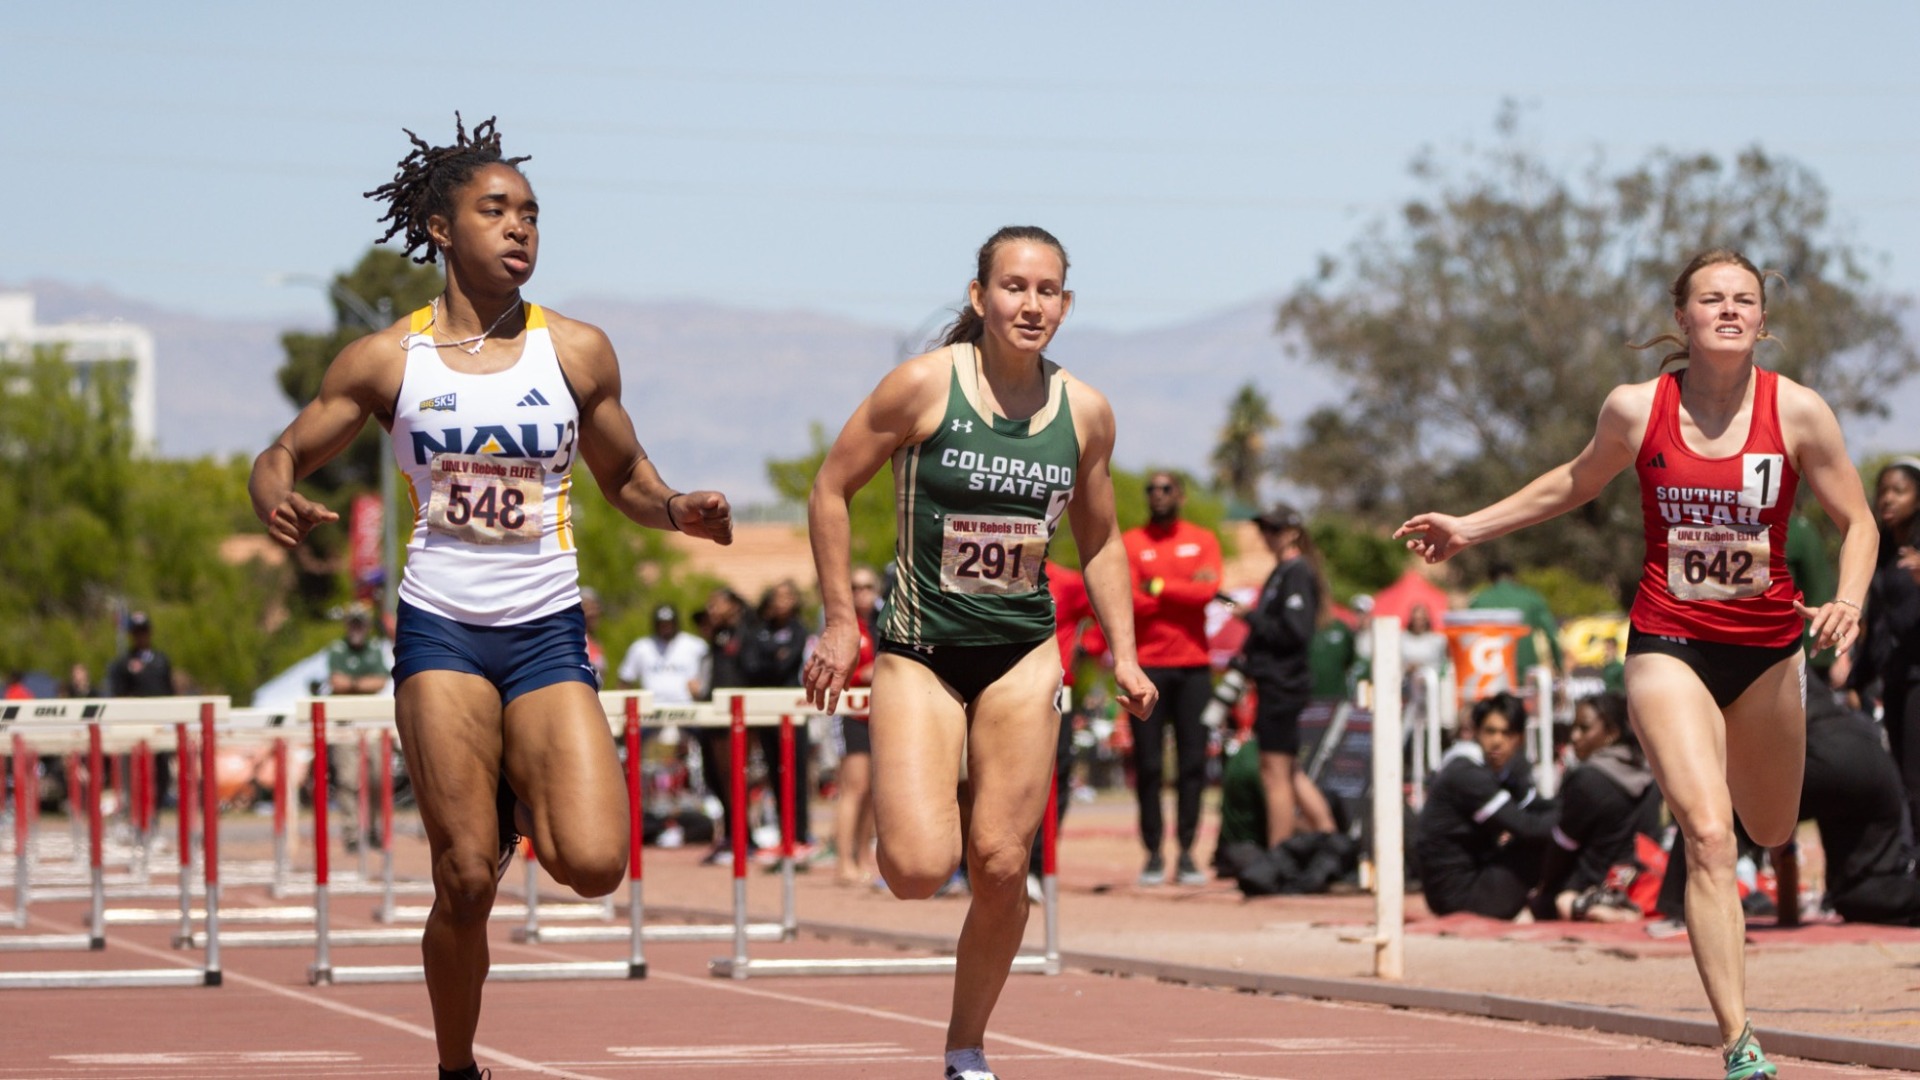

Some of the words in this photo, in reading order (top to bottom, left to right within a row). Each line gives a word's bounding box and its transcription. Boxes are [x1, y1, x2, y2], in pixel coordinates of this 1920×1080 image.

[410, 423, 565, 466] NAU
[551, 420, 575, 474] 3
[441, 460, 470, 472] UNLV
[472, 461, 507, 477] Rebels
[509, 464, 537, 479] ELITE
[941, 448, 1072, 486] COLORADO
[1754, 458, 1772, 506] 1
[968, 473, 1048, 500] STATE
[446, 483, 526, 530] 548
[1658, 502, 1763, 526] UTAH
[953, 520, 977, 532] UNLV
[980, 521, 1012, 534] Rebels
[1014, 523, 1038, 535] ELITE
[1677, 530, 1701, 541] UNLV
[1703, 531, 1735, 541] Rebels
[1737, 531, 1761, 541] ELITE
[956, 541, 1023, 579] 291
[1684, 550, 1753, 585] 642
[1470, 636, 1505, 675] G
